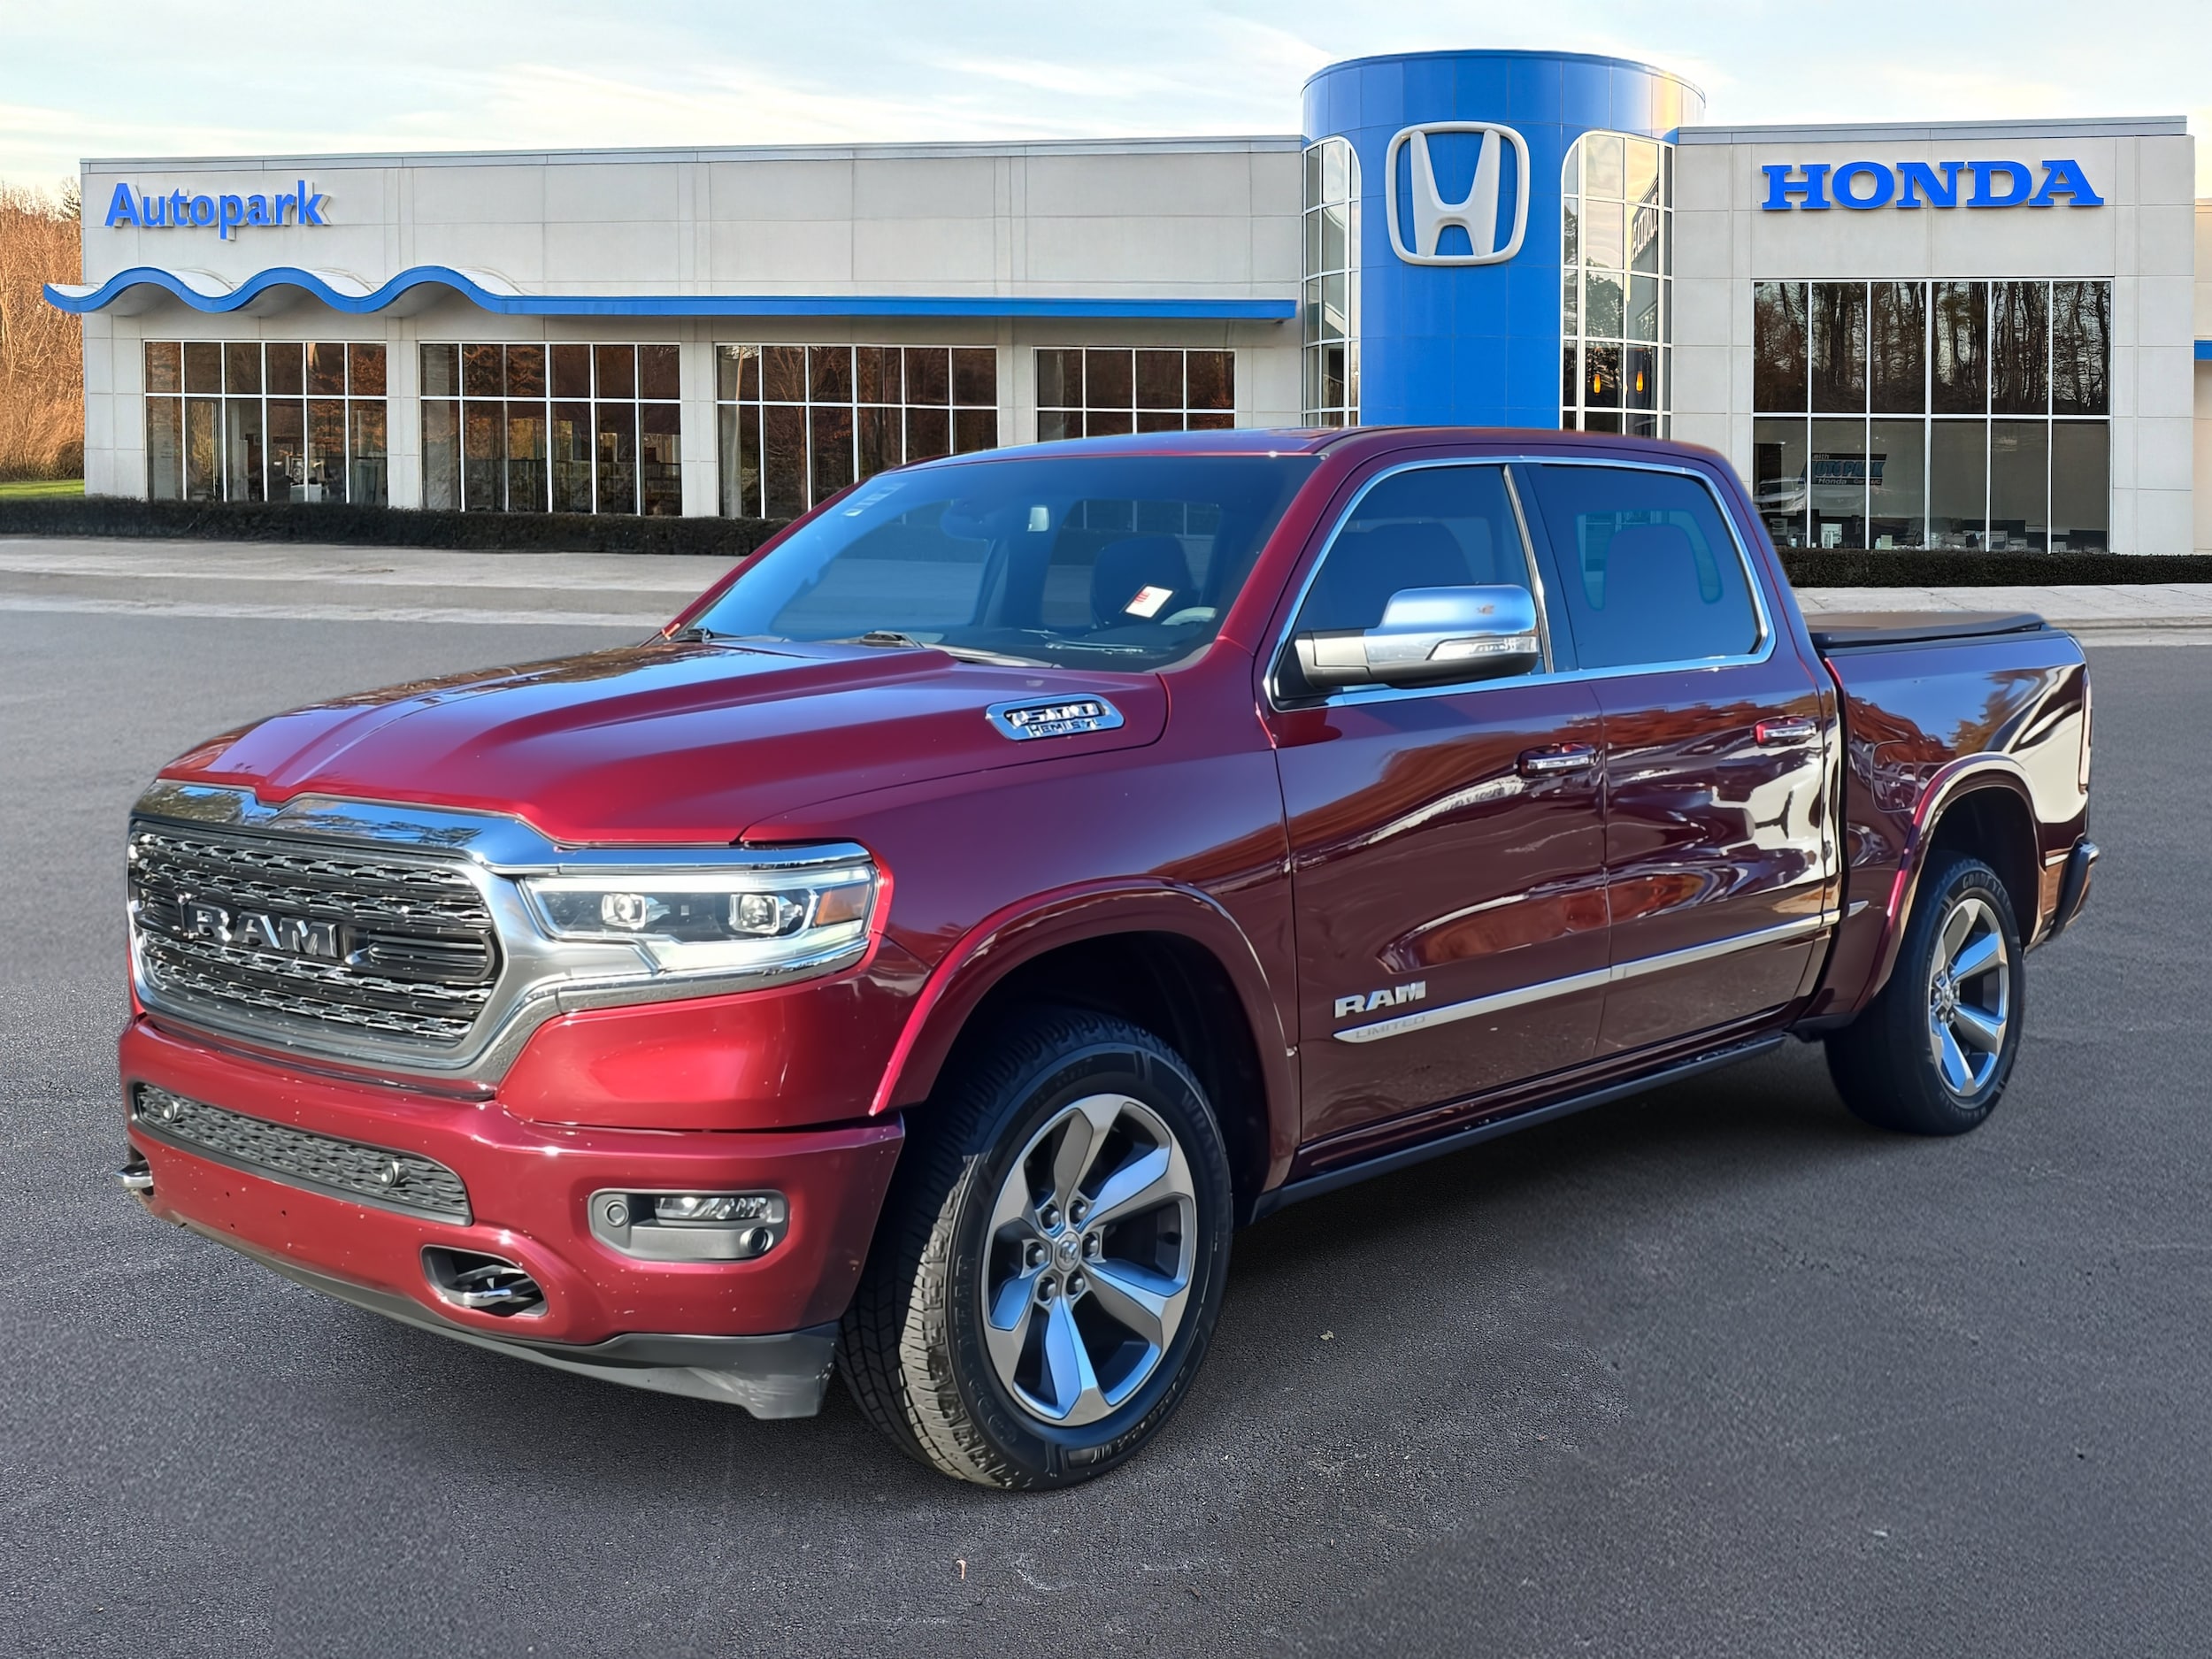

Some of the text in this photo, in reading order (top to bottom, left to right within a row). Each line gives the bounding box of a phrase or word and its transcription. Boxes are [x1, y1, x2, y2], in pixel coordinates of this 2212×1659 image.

[1762, 159, 2105, 211] HONDA
[104, 180, 326, 241] Autopark
[1799, 460, 1886, 478] AUTOPAK
[184, 900, 340, 958] RAM
[1334, 980, 1426, 1019] RAM
[1356, 1015, 1426, 1039] LIMITED
